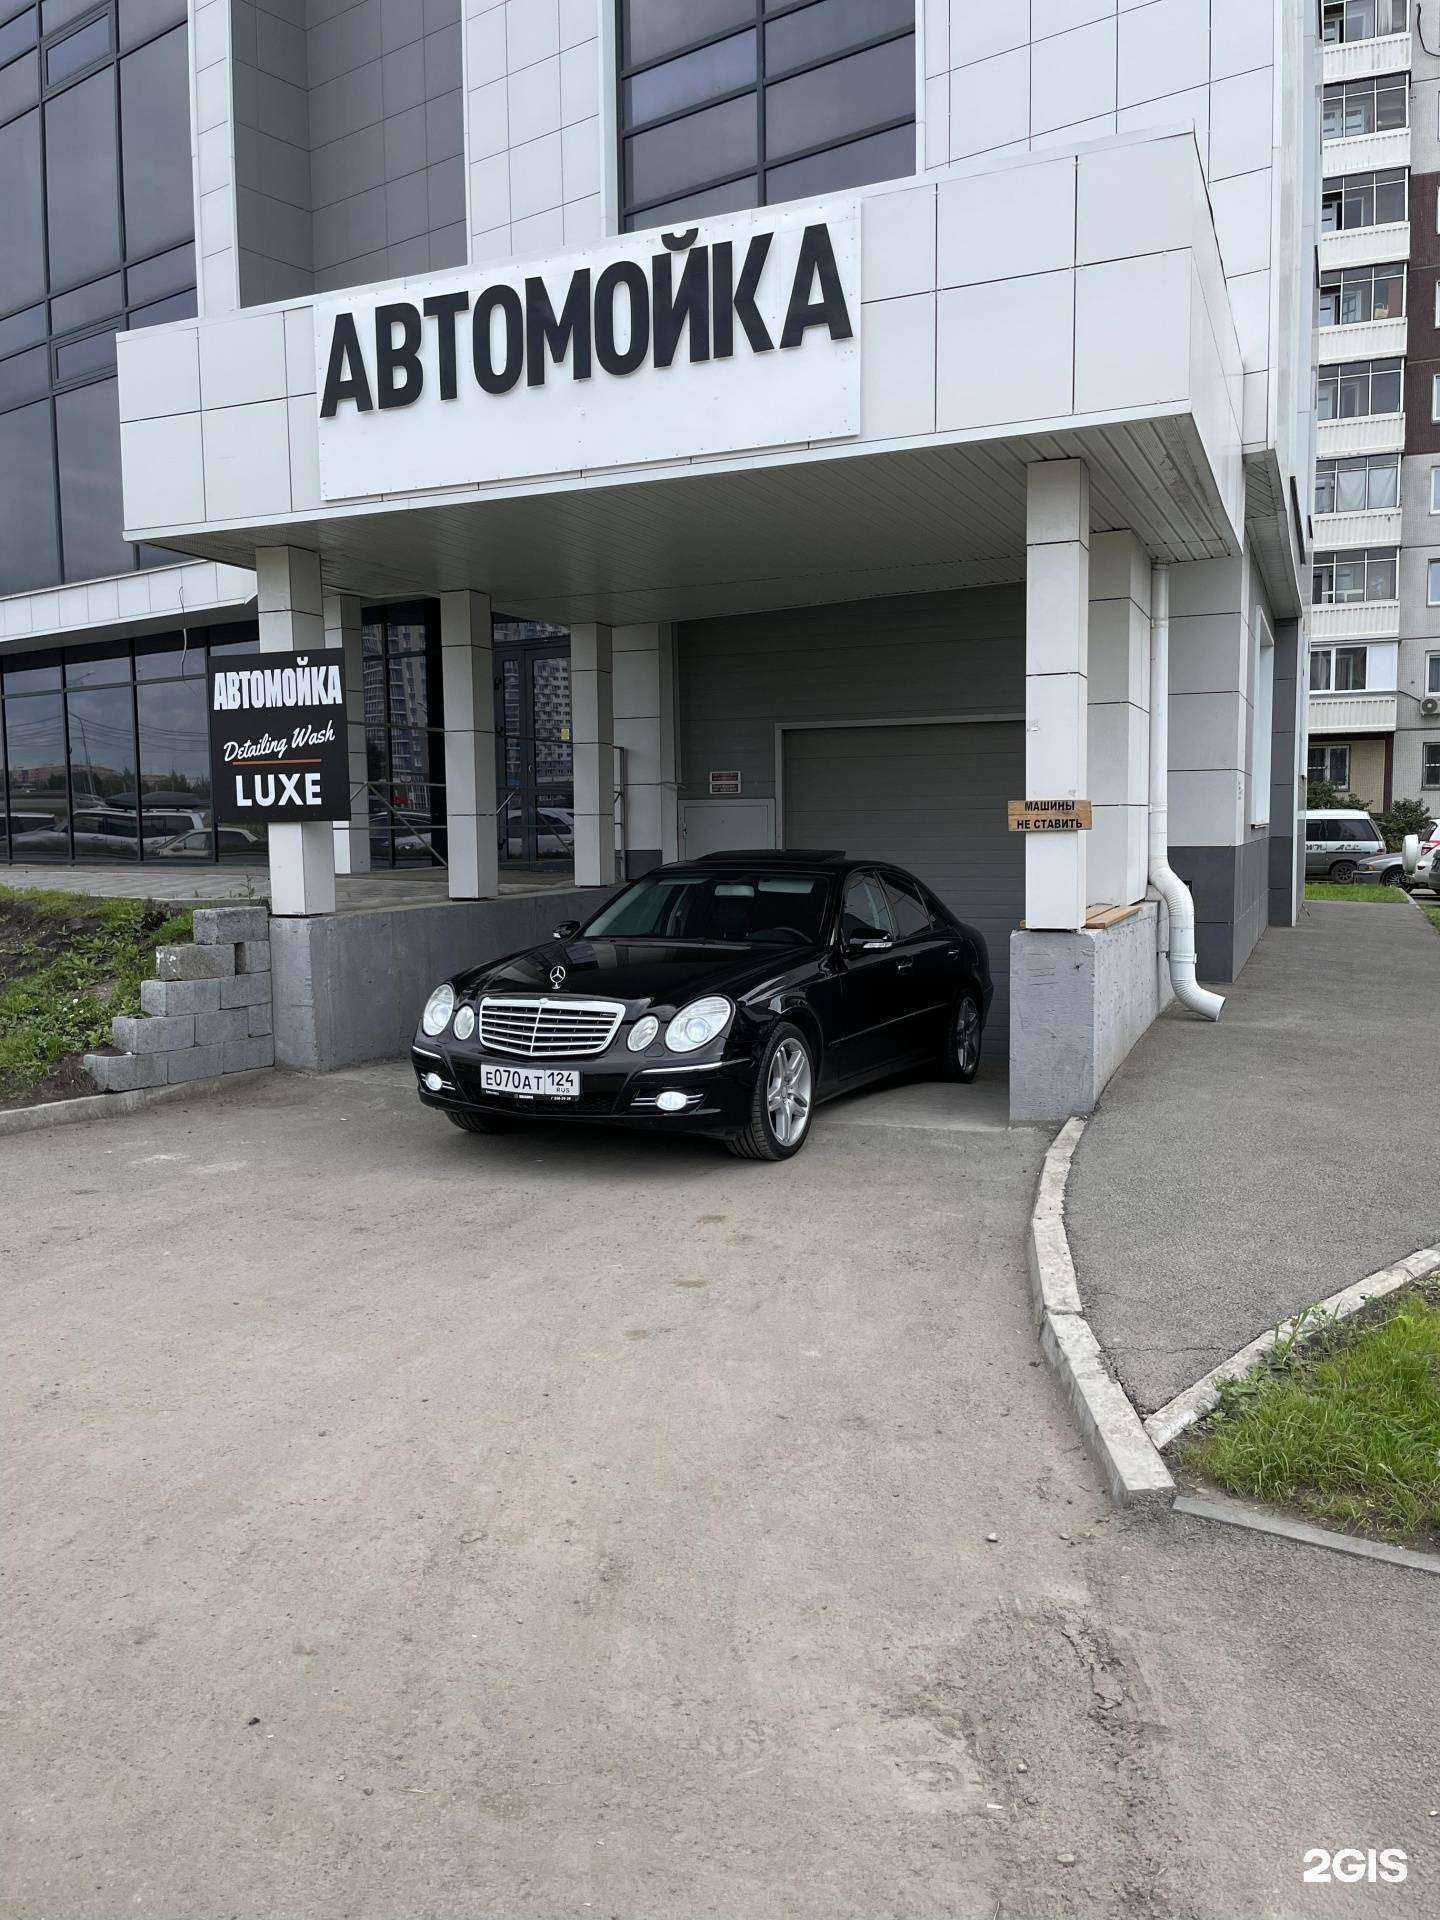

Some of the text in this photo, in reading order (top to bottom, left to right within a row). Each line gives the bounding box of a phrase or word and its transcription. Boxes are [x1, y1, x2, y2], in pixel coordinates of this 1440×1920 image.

[319, 223, 854, 418] АВТОМОЙКА
[213, 656, 343, 710] АВТОМОЙКА
[223, 720, 336, 761] Detailing Wash
[235, 773, 322, 807] LUXE
[1024, 800, 1075, 811] МАШИНЫ
[1017, 818, 1083, 829] НЕ СТАВИТЬ
[547, 1071, 574, 1087] 124
